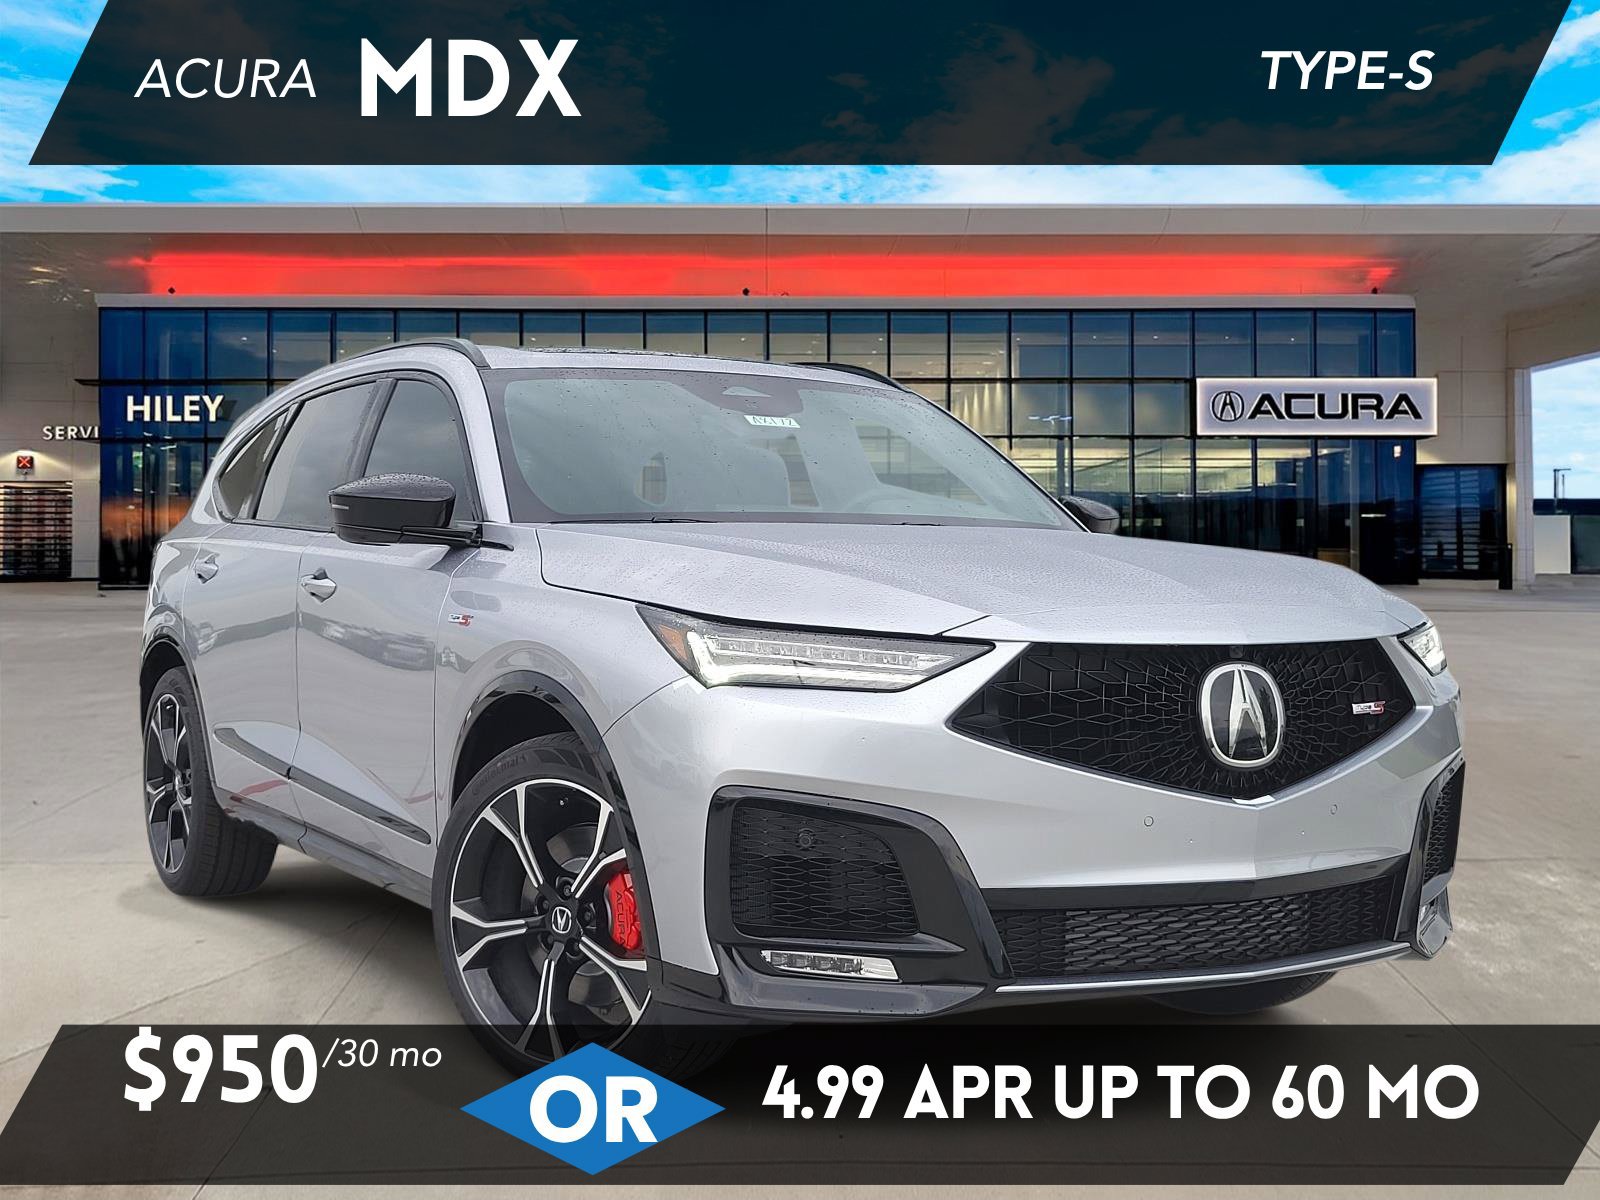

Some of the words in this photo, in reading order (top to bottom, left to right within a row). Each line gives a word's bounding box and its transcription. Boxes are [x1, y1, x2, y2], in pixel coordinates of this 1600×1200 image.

[126, 395, 224, 422] HILEY
[1249, 392, 1423, 420] ACURA
[615, 890, 627, 945] ACURA
